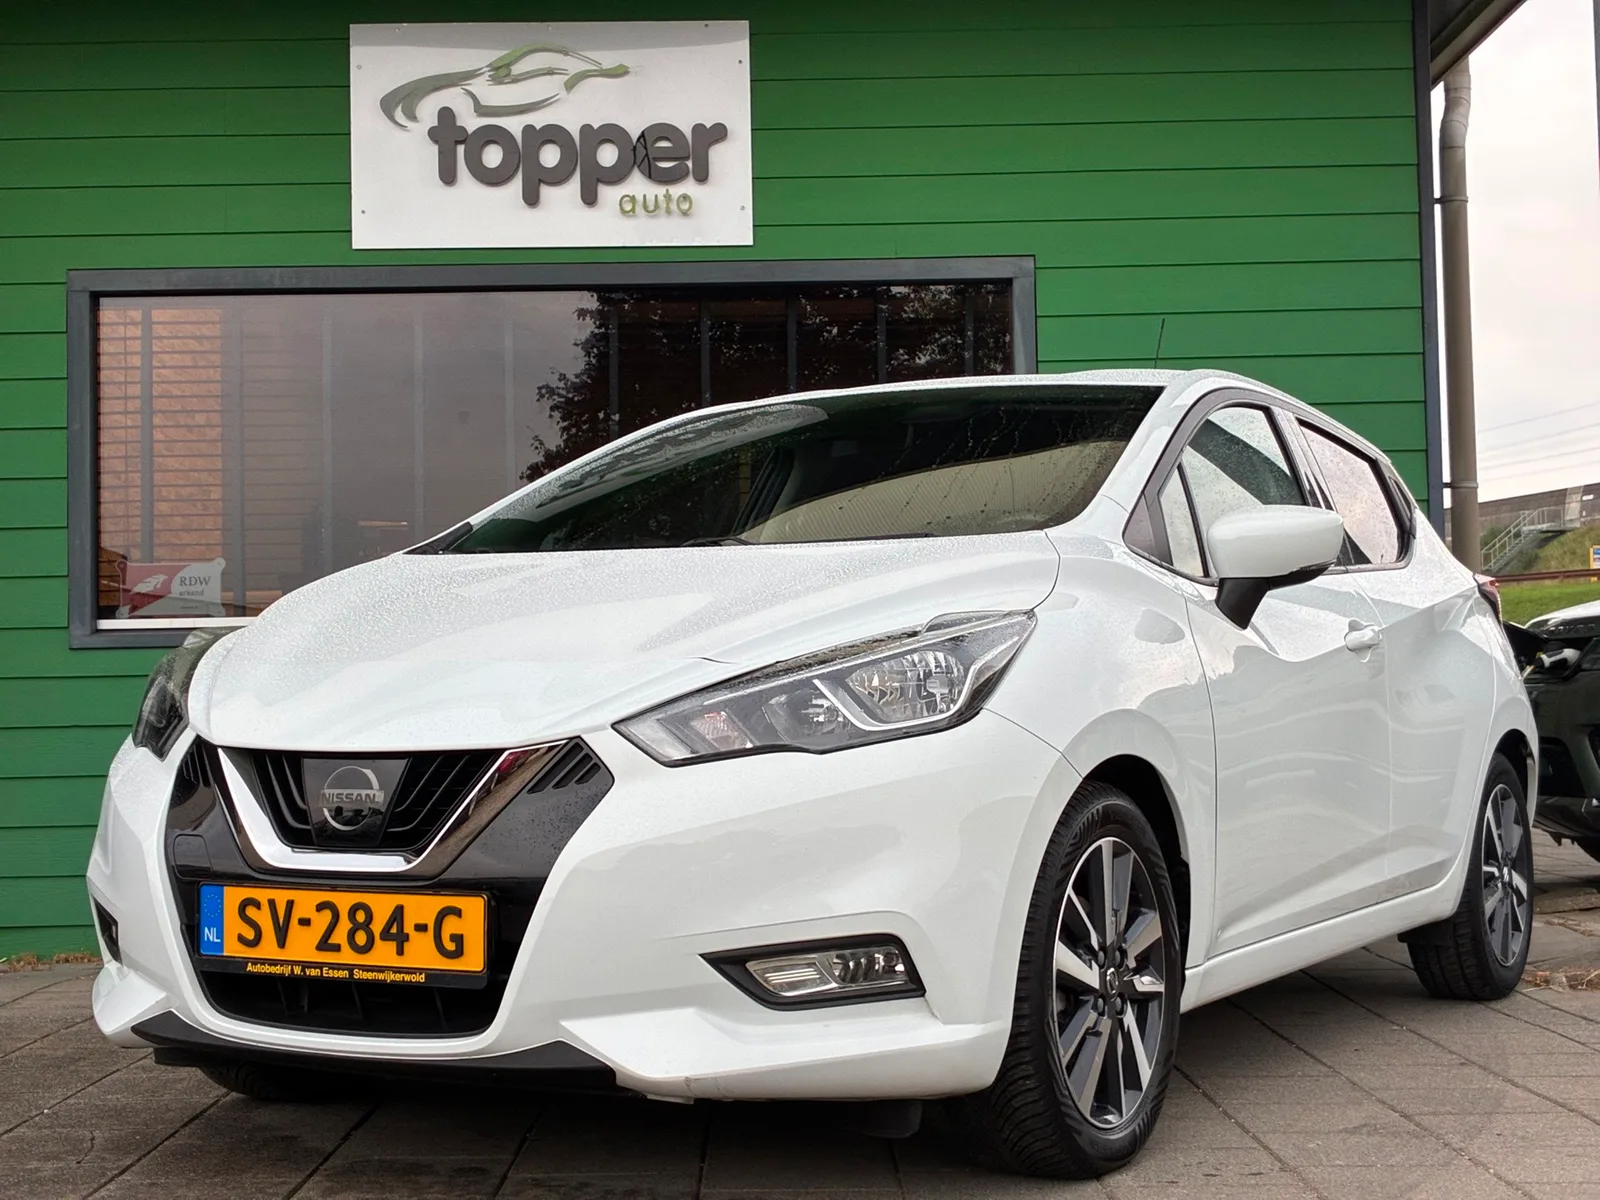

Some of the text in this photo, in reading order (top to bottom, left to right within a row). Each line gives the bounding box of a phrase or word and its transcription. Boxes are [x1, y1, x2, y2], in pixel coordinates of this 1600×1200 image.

[427, 106, 728, 206] topper
[619, 188, 693, 216] auto
[179, 576, 211, 587] RDW
[321, 793, 377, 805] NISSAN
[204, 926, 221, 942] NL
[237, 897, 464, 959] SV-284-G
[246, 962, 425, 982] Autobedrijf W. van Essen Steenwijkerwold
